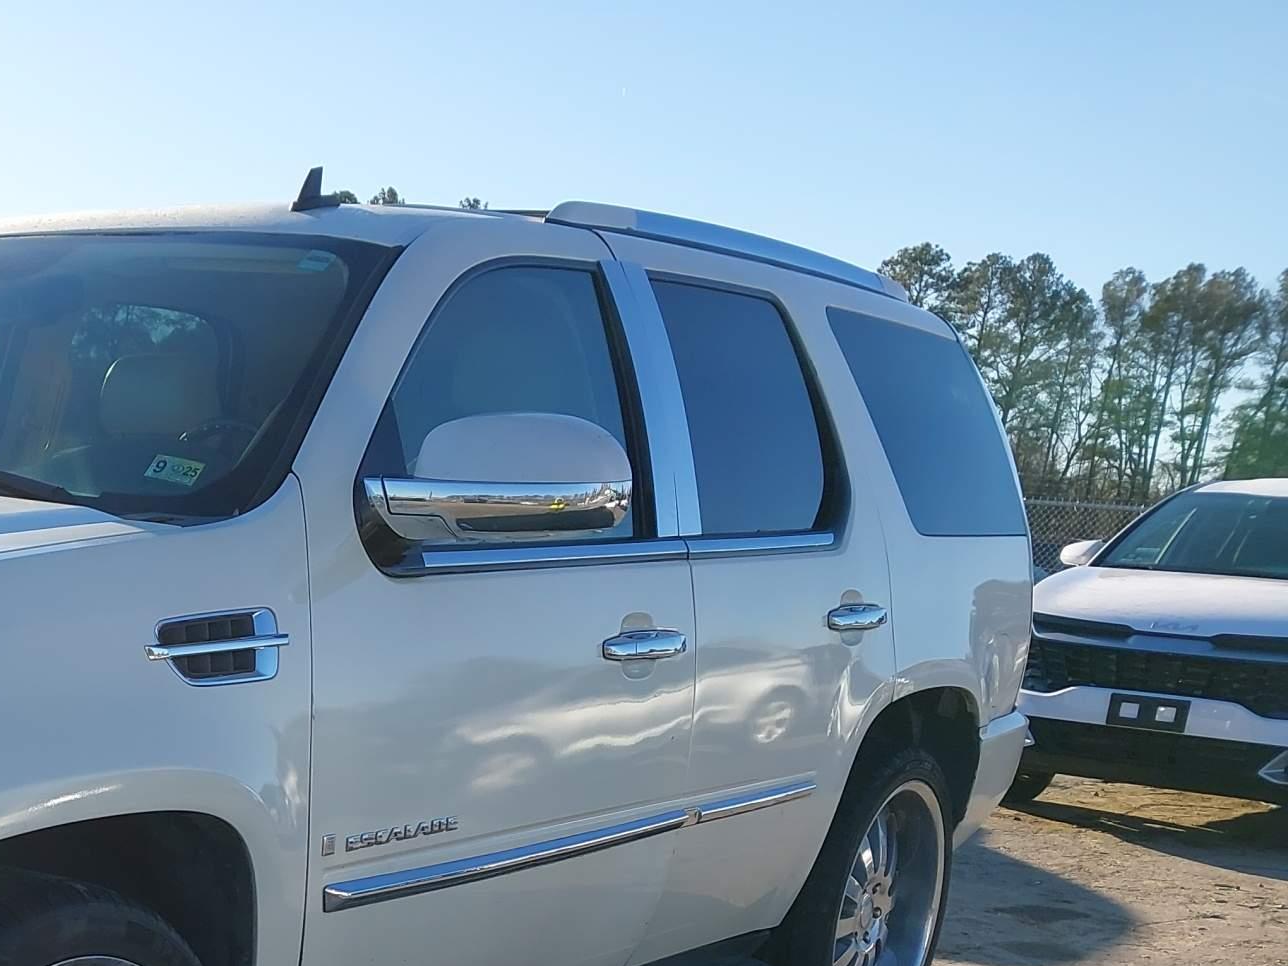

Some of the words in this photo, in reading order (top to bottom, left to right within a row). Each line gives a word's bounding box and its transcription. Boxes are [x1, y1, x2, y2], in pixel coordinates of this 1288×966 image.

[153, 460, 168, 473] 9
[183, 466, 200, 477] 25
[345, 816, 459, 852] ESCALADE
